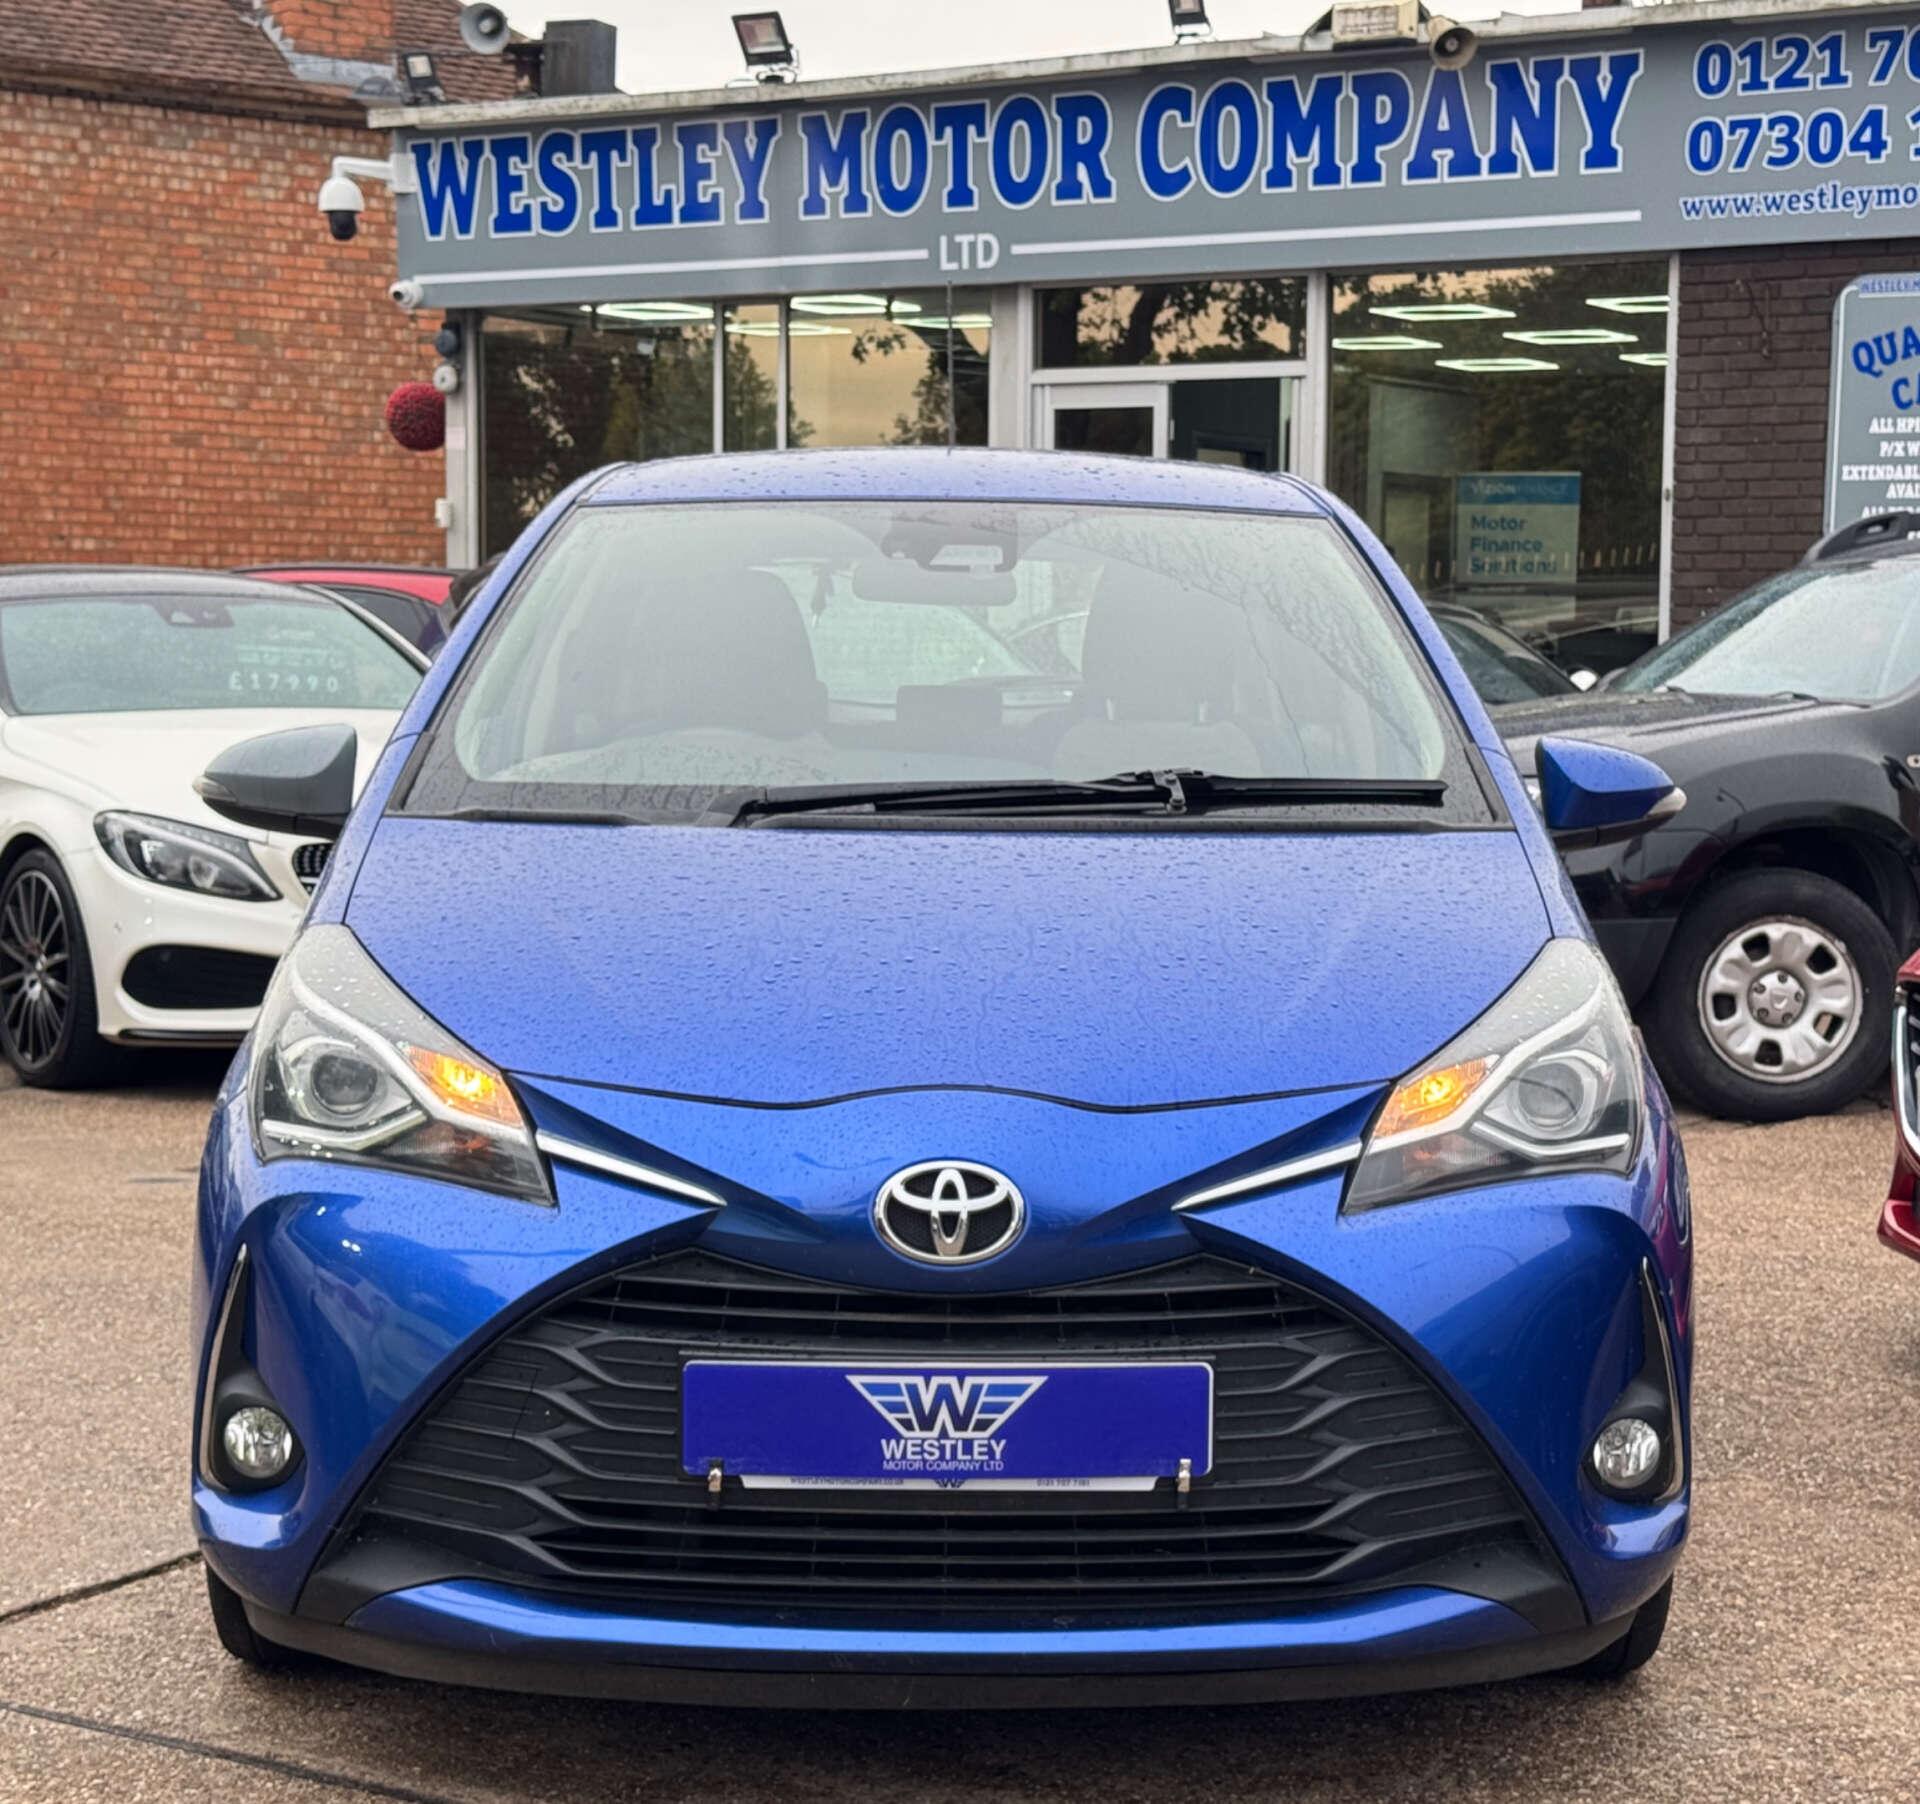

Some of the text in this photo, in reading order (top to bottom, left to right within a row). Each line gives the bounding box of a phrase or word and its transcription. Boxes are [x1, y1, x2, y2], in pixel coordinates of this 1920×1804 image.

[1693, 30, 1852, 99] 0121
[409, 48, 1645, 241] WESTLEY MOTOR COMPANY
[1685, 104, 1891, 175] 07304
[939, 233, 1000, 270] LTD
[1891, 372, 1920, 410] C
[1869, 417, 1895, 434] ALL
[1879, 440, 1905, 457] P/X
[1471, 515, 1528, 531] Motor
[1471, 536, 1543, 553] Finance
[880, 1438, 1007, 1461] WESTLEY
[882, 1461, 1004, 1472] MOTOR COMPANY LTD
